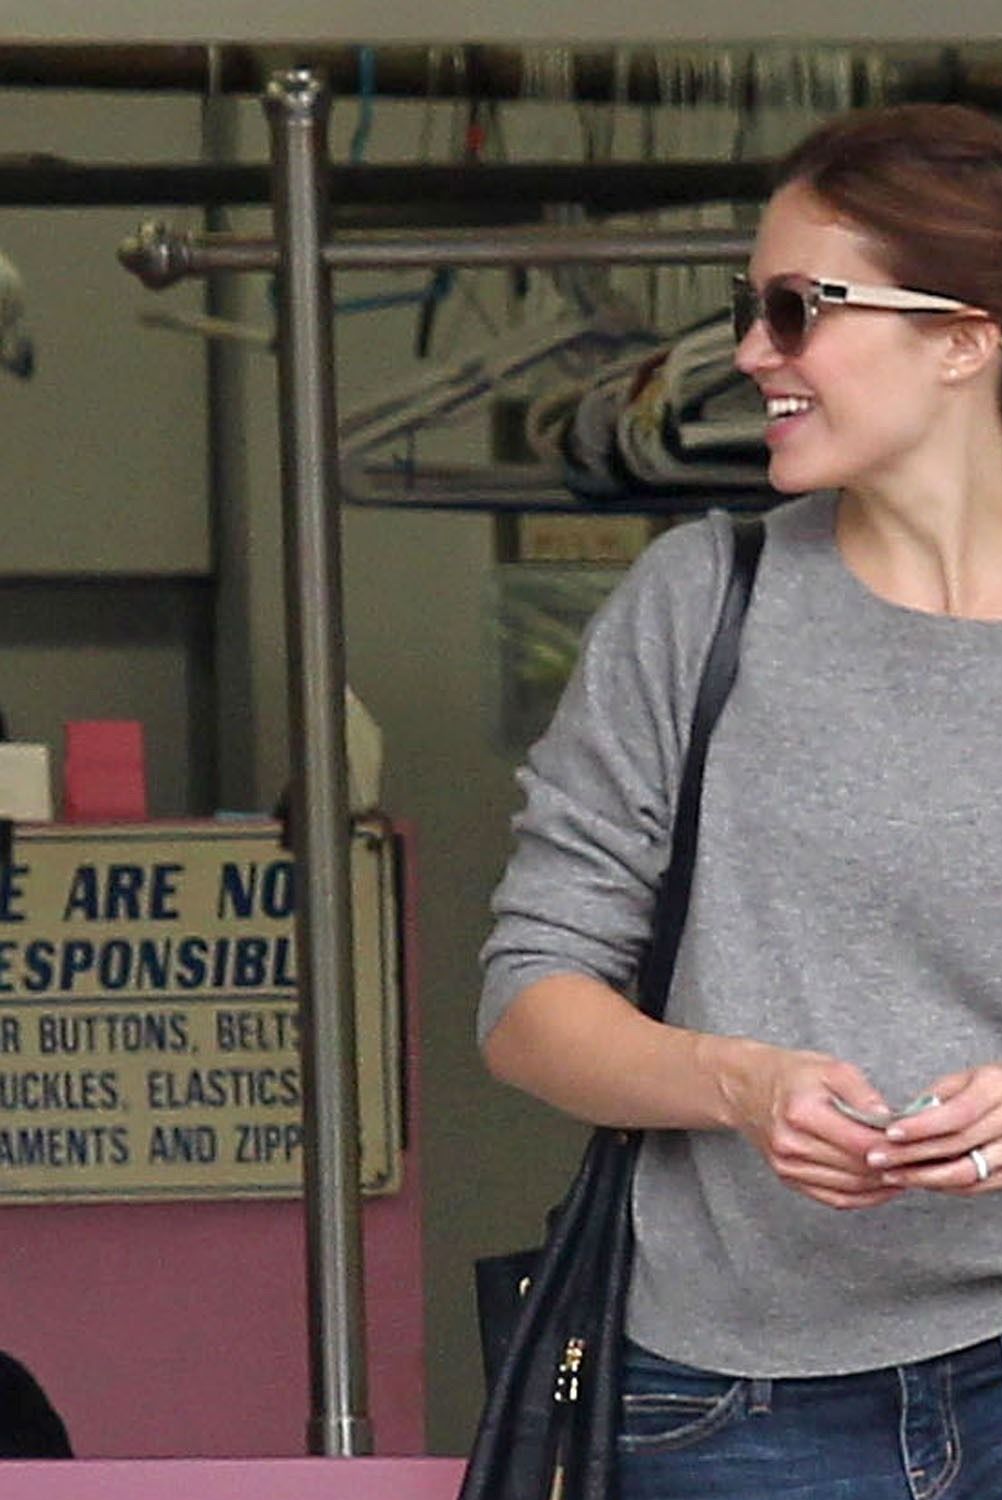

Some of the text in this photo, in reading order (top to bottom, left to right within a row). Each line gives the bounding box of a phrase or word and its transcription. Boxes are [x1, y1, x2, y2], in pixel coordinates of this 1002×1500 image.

[62, 863, 185, 921] ARE
[217, 860, 297, 920] NO
[147, 1123, 217, 1165] AND
